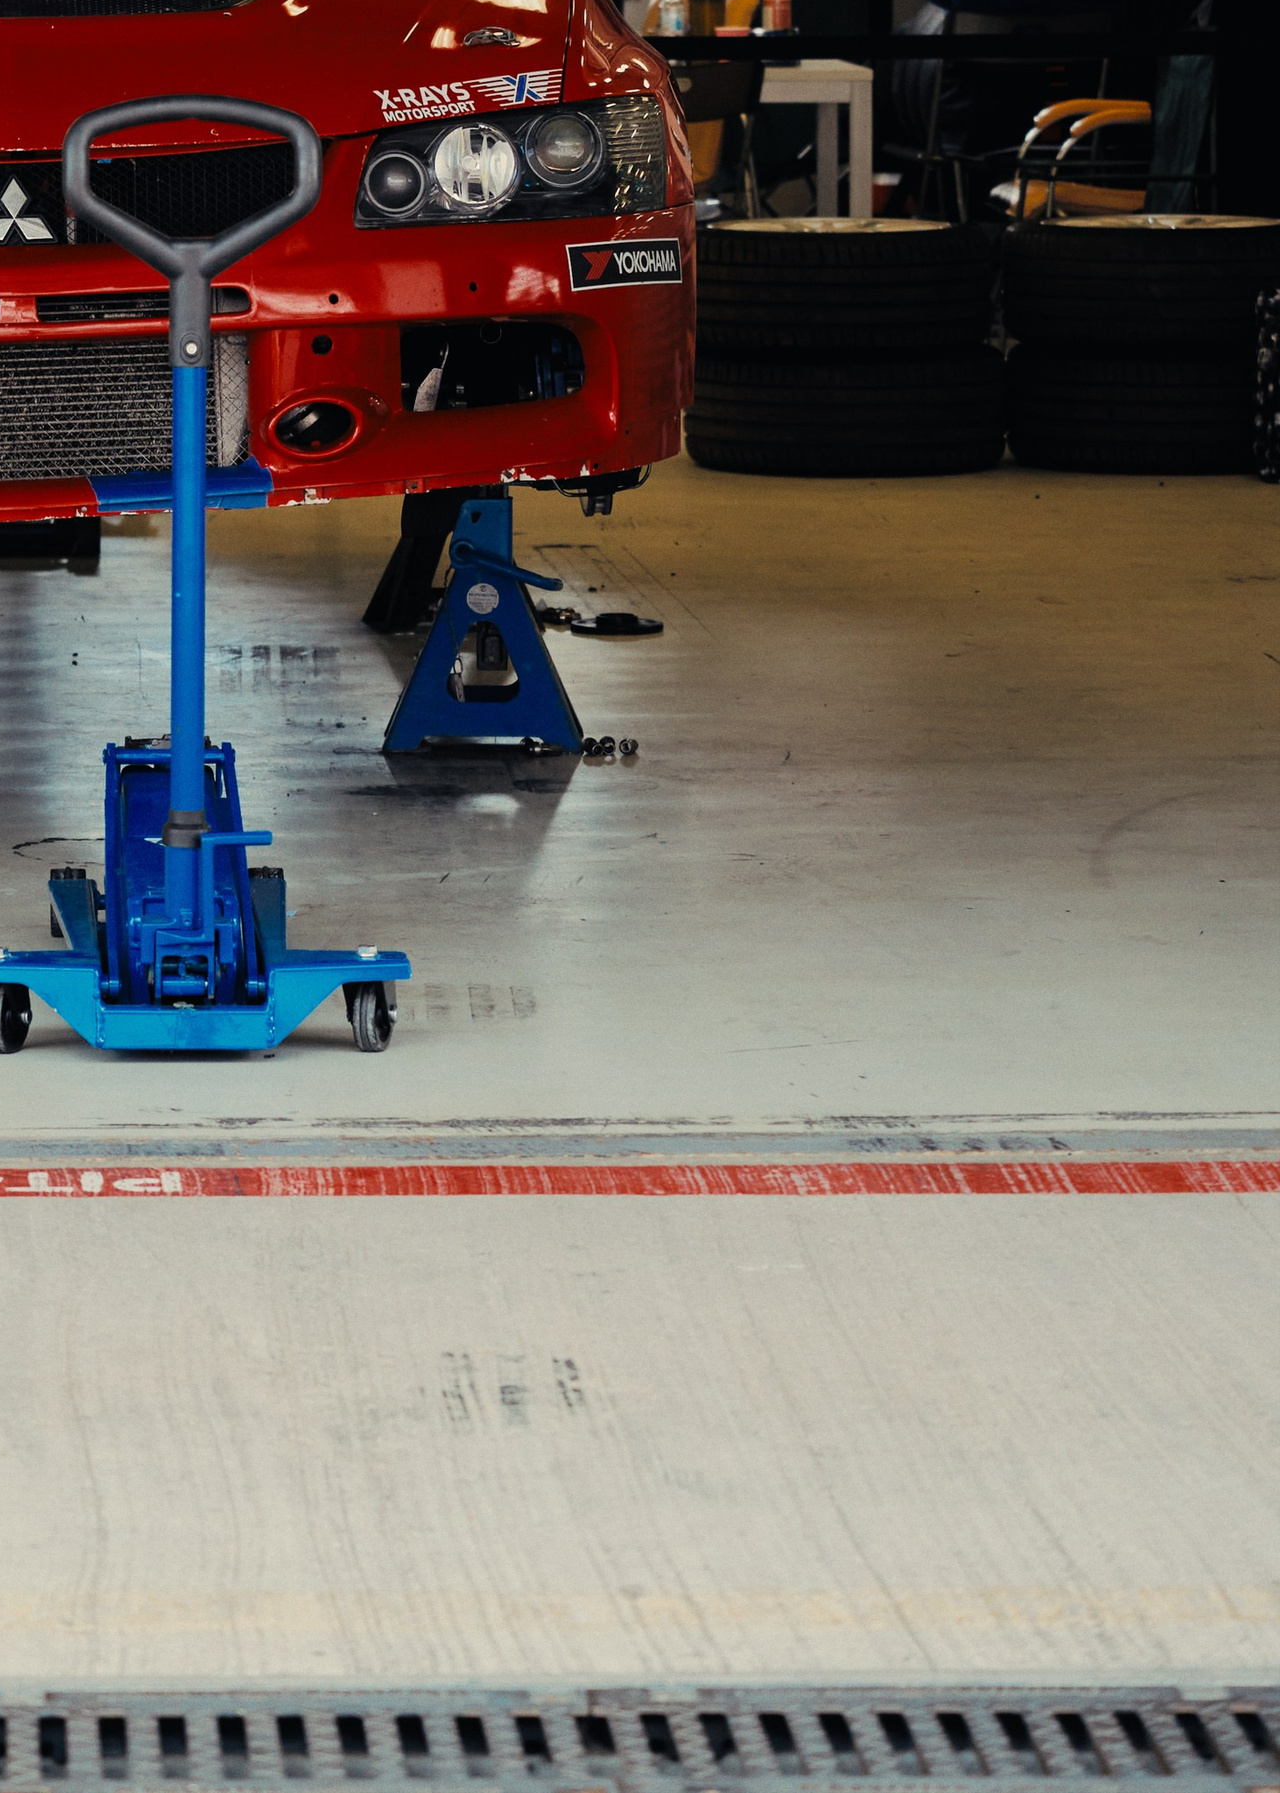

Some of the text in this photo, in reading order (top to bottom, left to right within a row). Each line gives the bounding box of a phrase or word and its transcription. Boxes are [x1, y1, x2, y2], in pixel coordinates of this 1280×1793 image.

[373, 82, 471, 110] X-RAYS
[382, 101, 476, 123] MOTORSPORT
[613, 249, 677, 274] YOKOHAMA
